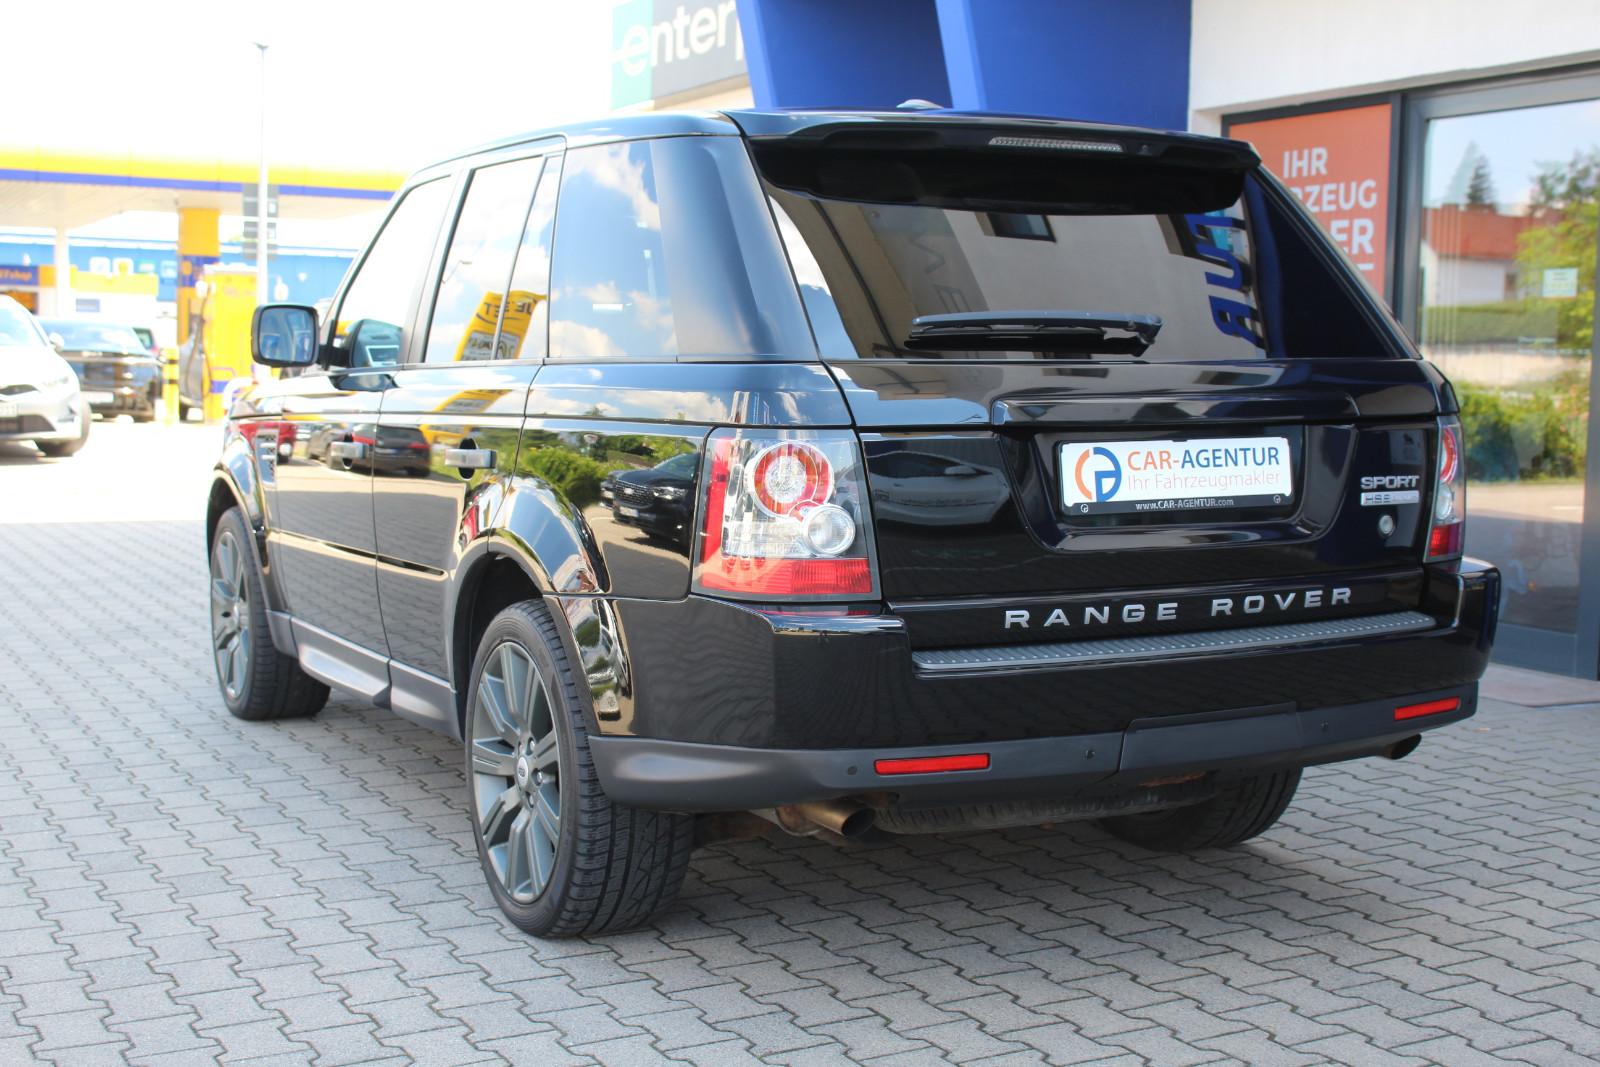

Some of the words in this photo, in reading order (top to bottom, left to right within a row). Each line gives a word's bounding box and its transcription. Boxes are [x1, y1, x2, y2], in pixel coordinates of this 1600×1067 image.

[608, 0, 744, 77] enter
[1283, 147, 1328, 178] IHR
[1127, 447, 1280, 471] CAR-AGENTUR
[1128, 475, 1151, 490] Ihr
[1155, 470, 1280, 492] Fahrzeugmakler
[1360, 475, 1420, 489] SPORT
[1135, 498, 1234, 511] www.CAR-AGENTUR.com
[1004, 602, 1179, 629] RANGE
[1211, 587, 1352, 617] ROVER
